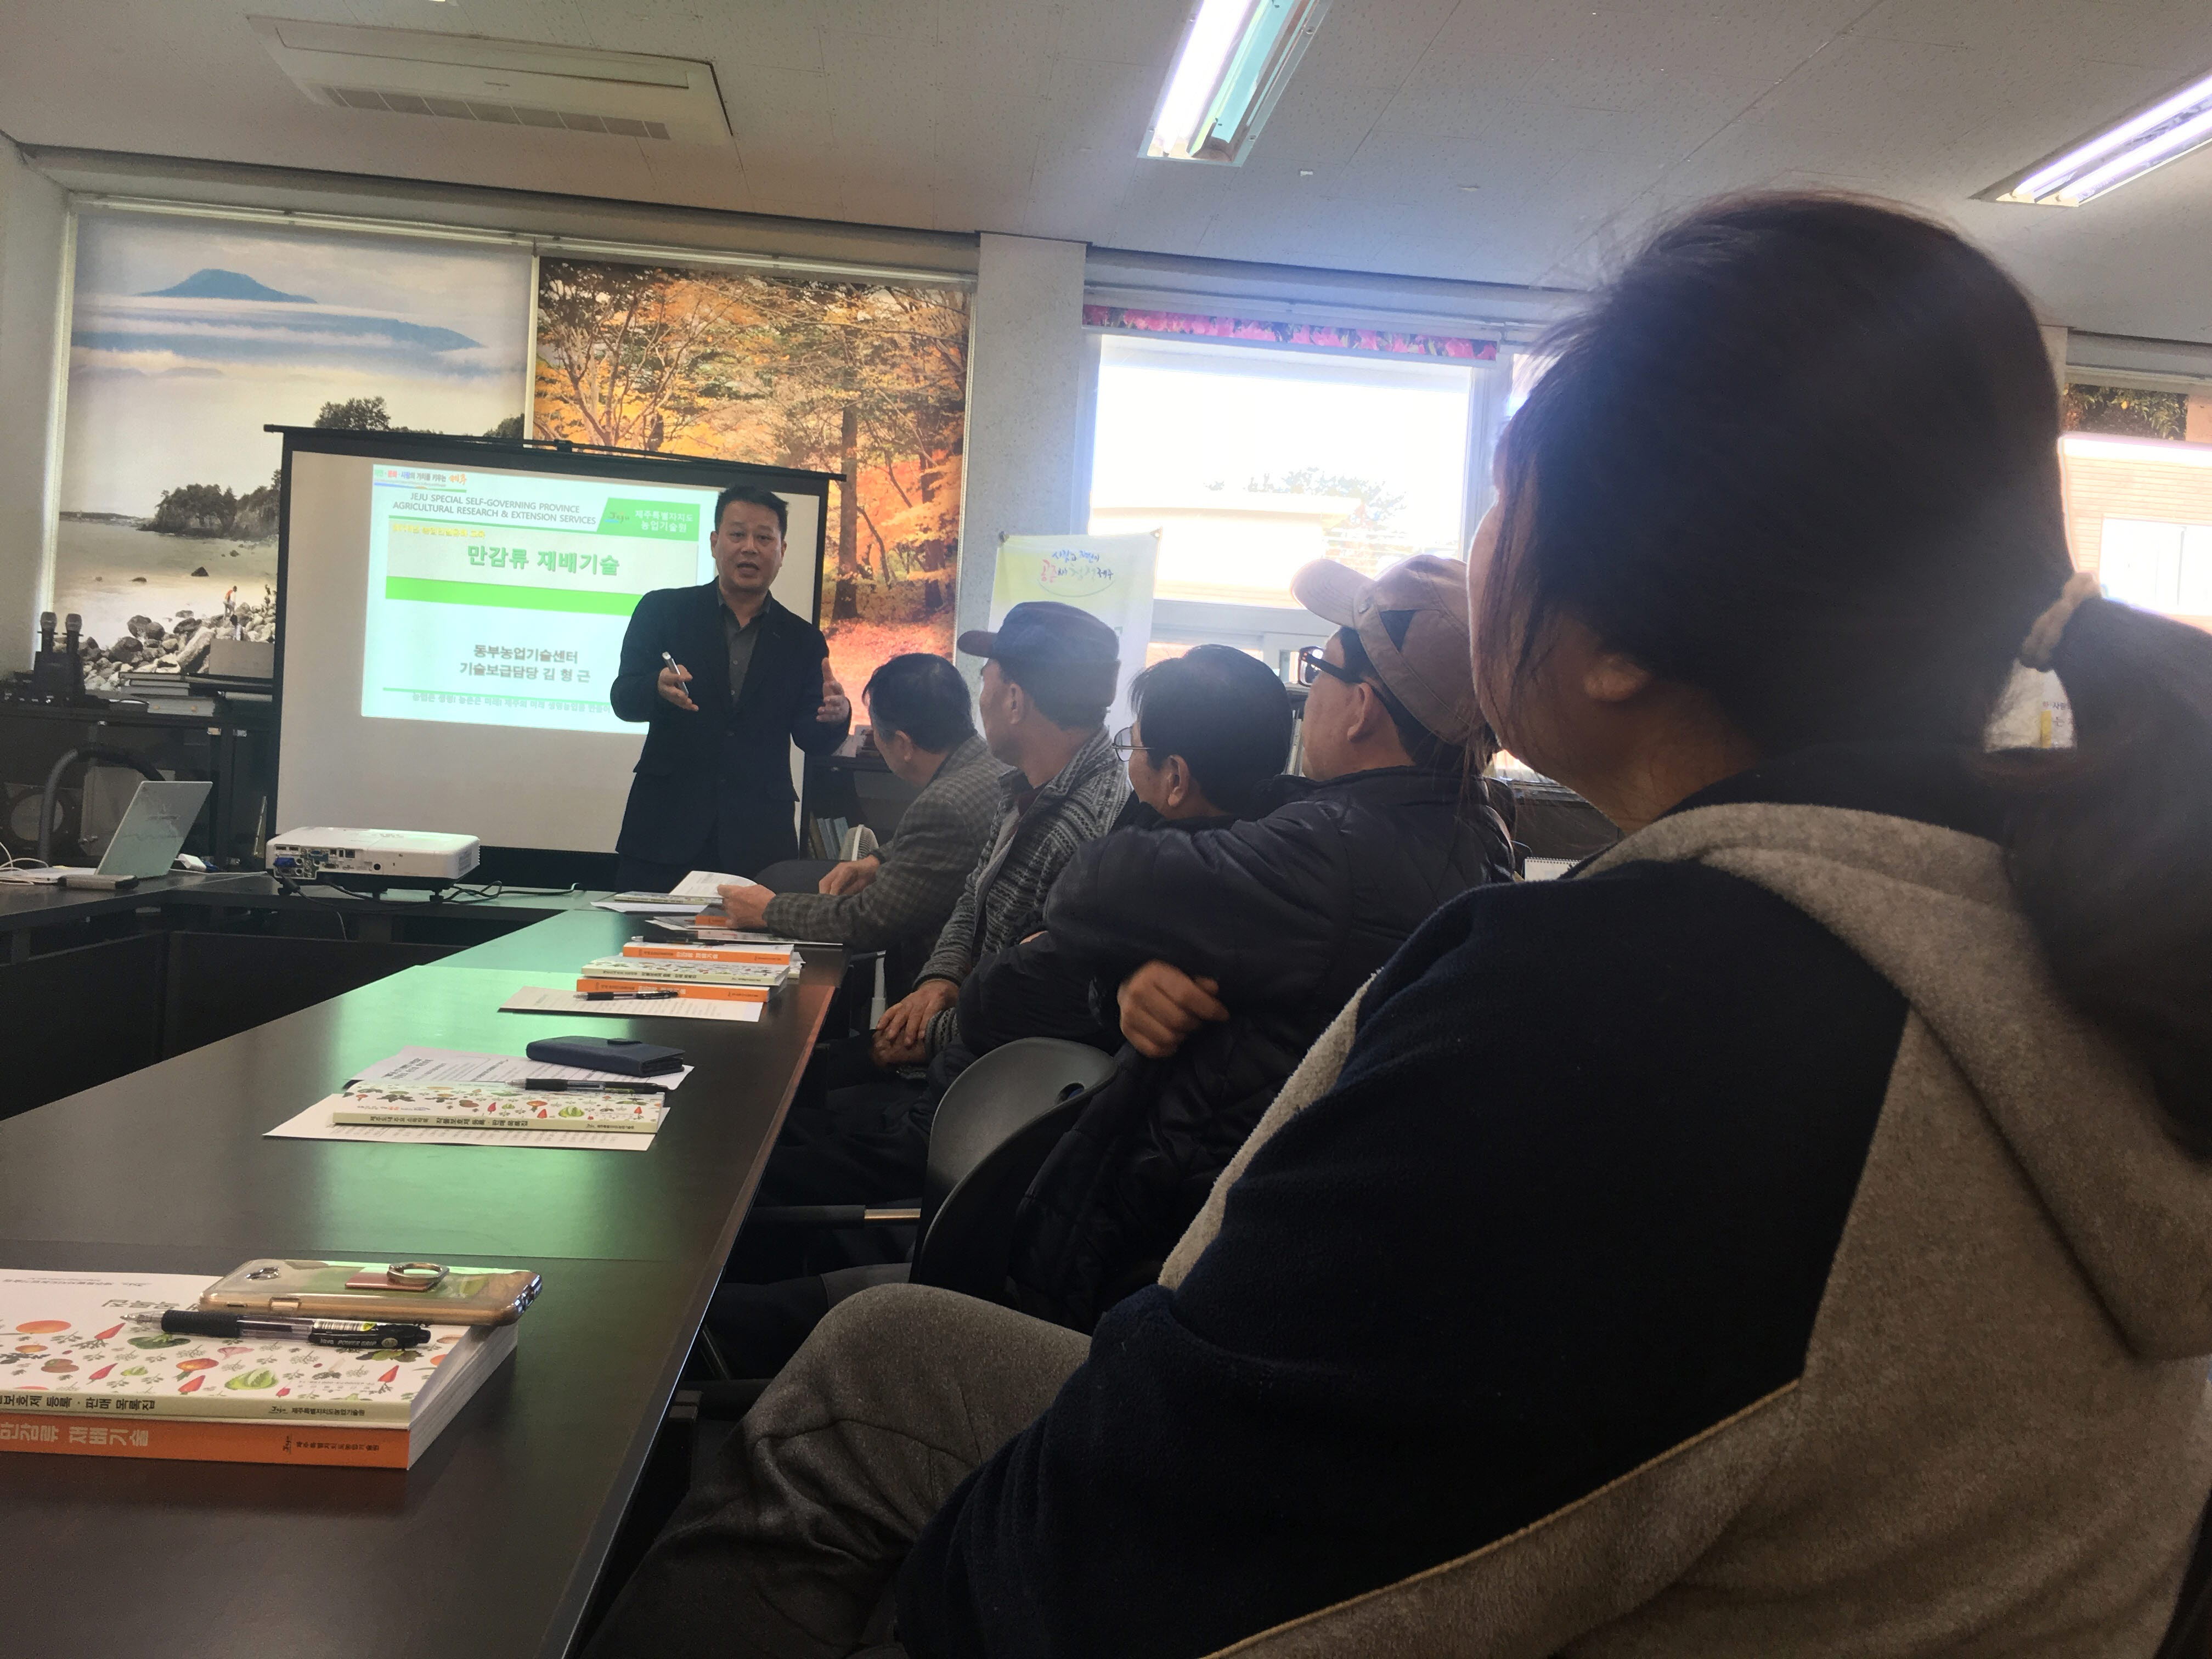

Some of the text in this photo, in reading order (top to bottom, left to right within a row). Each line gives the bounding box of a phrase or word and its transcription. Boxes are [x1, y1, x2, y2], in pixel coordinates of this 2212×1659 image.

[393, 501, 454, 515] AGRICULTURAL
[457, 506, 499, 517] RESEARCH
[511, 512, 557, 522] EXTENSION
[560, 516, 596, 525] SERVICES
[410, 493, 580, 513] JEJU SPECIAL SELF-GOVERNING PROVINCE
[635, 510, 693, 522] 제주특별자치도
[641, 520, 687, 533] 농업기술원
[467, 545, 620, 576] 만감류 재배기술
[473, 644, 578, 664] 동부농업기술센터
[460, 662, 591, 683] 기술보급담당 김 형 근
[0, 1395, 42, 1407] 보호제
[47, 1396, 72, 1408] 등록
[86, 1397, 111, 1409] 판매
[116, 1398, 155, 1411] 목록집
[69, 1425, 149, 1447] 재배기술
